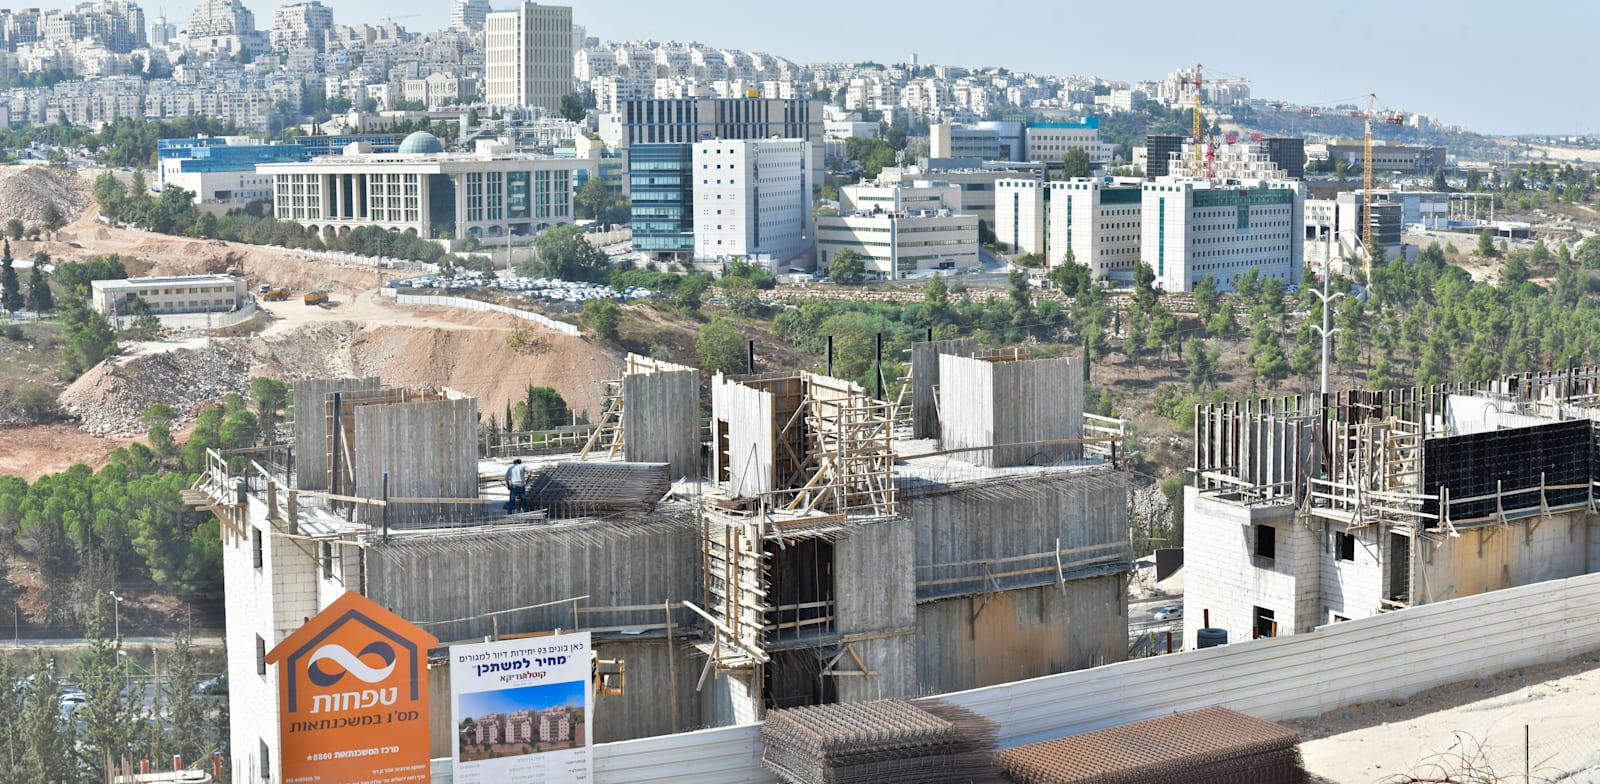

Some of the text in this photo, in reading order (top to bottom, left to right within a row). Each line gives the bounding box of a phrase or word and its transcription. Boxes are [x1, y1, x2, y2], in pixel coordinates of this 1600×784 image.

[459, 643, 584, 663] כאן בונים 93 יחידות דיור למגורים
[309, 687, 398, 714] טפחות
[289, 715, 382, 733] במשכנתאות
[380, 746, 400, 754] מרכז
